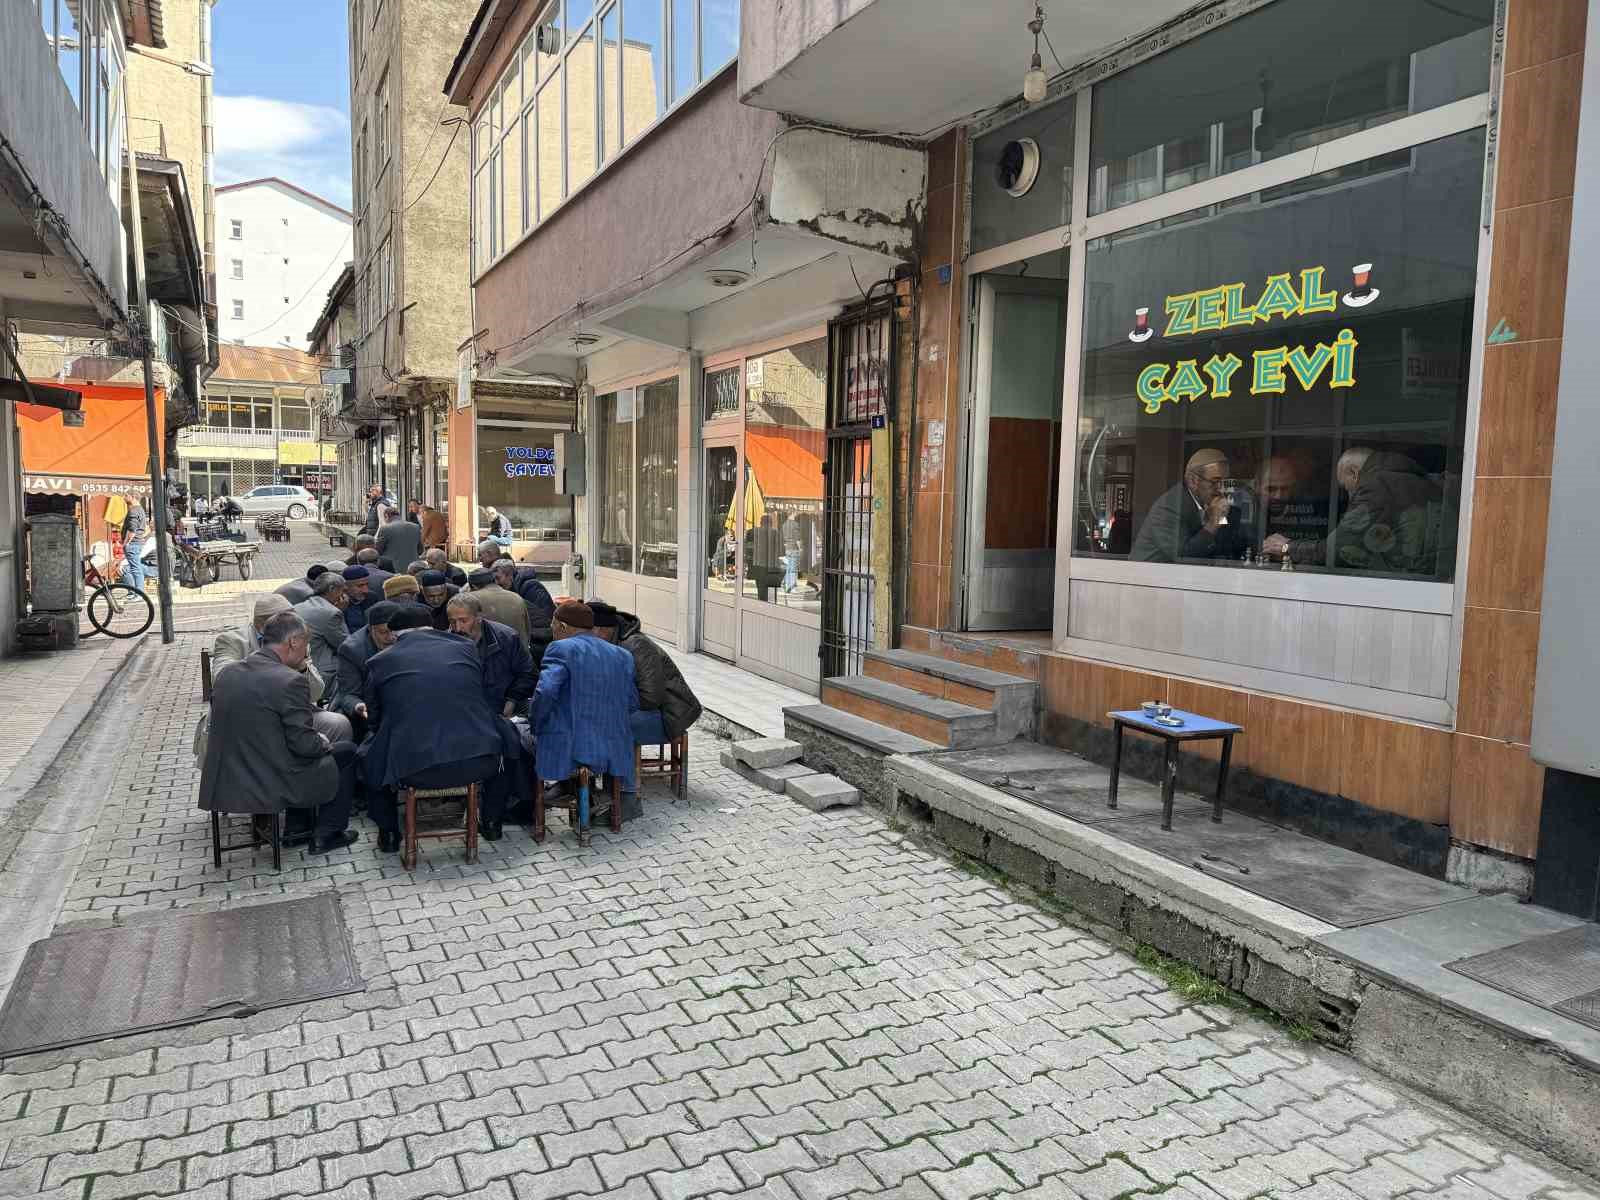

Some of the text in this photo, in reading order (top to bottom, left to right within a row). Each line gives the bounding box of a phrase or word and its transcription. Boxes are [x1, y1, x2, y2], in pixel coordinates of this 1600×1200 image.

[1163, 266, 1338, 338] ZELAL
[1136, 352, 1243, 414] ÇAY
[1250, 328, 1359, 395] EVİ
[82, 483, 109, 493] 0535
